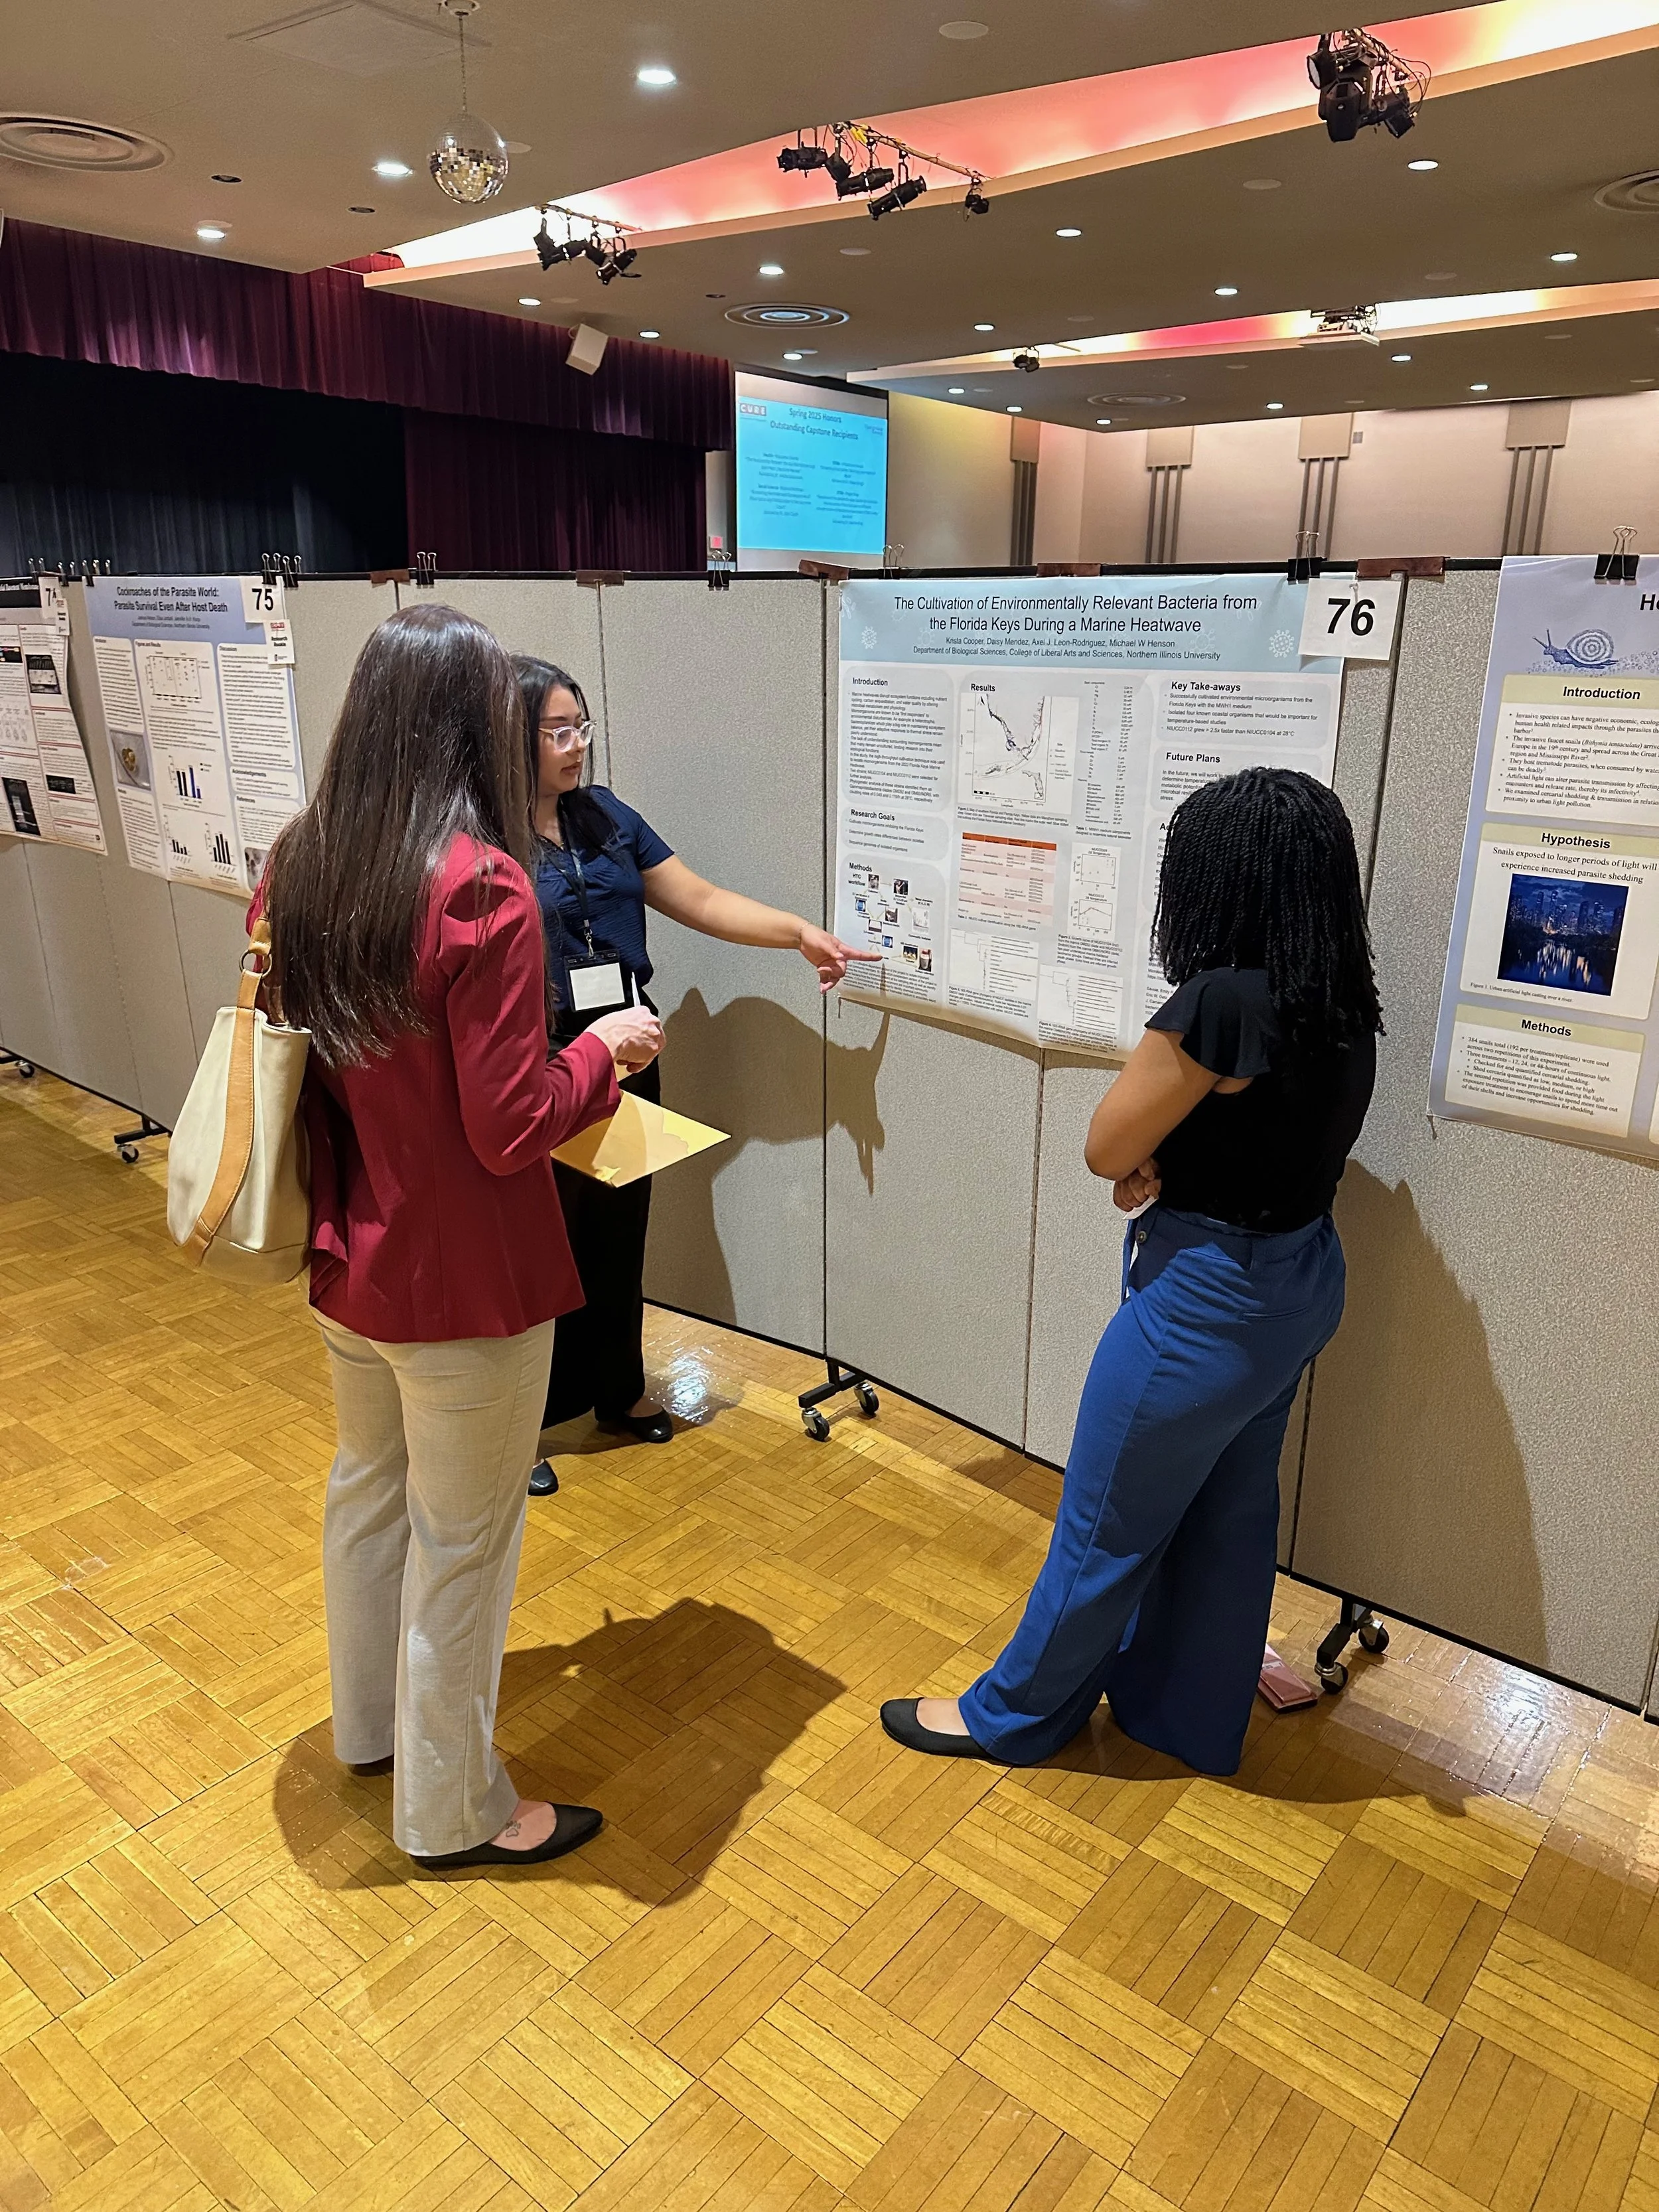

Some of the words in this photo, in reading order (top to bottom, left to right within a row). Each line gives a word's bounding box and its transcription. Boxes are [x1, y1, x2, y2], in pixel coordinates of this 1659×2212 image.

[741, 404, 766, 415] CURE
[770, 419, 805, 435] Outstanding
[806, 425, 831, 436] Capstone
[831, 428, 858, 440] Recipients
[116, 586, 151, 596] Cockroaches
[152, 587, 159, 596] of
[159, 587, 170, 596] the
[171, 587, 196, 597] Parasite
[197, 587, 219, 597] World:
[113, 600, 135, 610] Parasite
[135, 601, 158, 611] Survival
[158, 601, 174, 611] Even
[175, 601, 190, 611] After
[191, 601, 208, 611] Host
[208, 602, 228, 612] Death
[252, 588, 273, 611] 75
[894, 597, 914, 609] The
[917, 596, 973, 609] Cultivation
[977, 596, 989, 609] of
[991, 595, 1088, 613] Environmentally
[1092, 595, 1153, 609] Relevant
[1157, 595, 1217, 609] Bacteria
[1222, 594, 1256, 609] from
[1327, 598, 1375, 635] 76
[929, 617, 946, 630] the
[950, 617, 987, 630] Florida
[991, 617, 1020, 634] Keys
[1024, 617, 1064, 634] During
[1068, 620, 1076, 630] a
[1080, 617, 1125, 631] Marine
[1130, 617, 1201, 632] Heatwave
[963, 636, 985, 645] Cooper,
[986, 637, 1003, 646] Daisy
[1004, 637, 1030, 646] Mendez,
[913, 646, 944, 654] Department
[952, 646, 978, 656] Biological
[979, 647, 1007, 656] Sciences,
[1009, 648, 1032, 657] College
[1092, 649, 1124, 658] Sciences,
[1184, 650, 1220, 661] University
[852, 677, 889, 686] Introduction
[971, 683, 995, 692] Results
[1171, 681, 1188, 691] Key
[1190, 682, 1241, 693] Take-aways
[1563, 686, 1640, 700] Introduction
[1166, 752, 1194, 761] Future
[1196, 754, 1220, 763] Plans
[851, 809, 877, 819] Research
[879, 812, 895, 822] Goals
[1542, 832, 1611, 849] Hypothesis
[1492, 846, 1514, 855] Snails
[1556, 853, 1580, 863] longer
[1621, 859, 1639, 869] light
[1642, 862, 1658, 871] will
[849, 862, 872, 872] Methods
[1500, 862, 1540, 871] experience
[1541, 866, 1575, 875] increased
[1609, 872, 1643, 884] shedding
[1522, 1019, 1572, 1037] Methods
